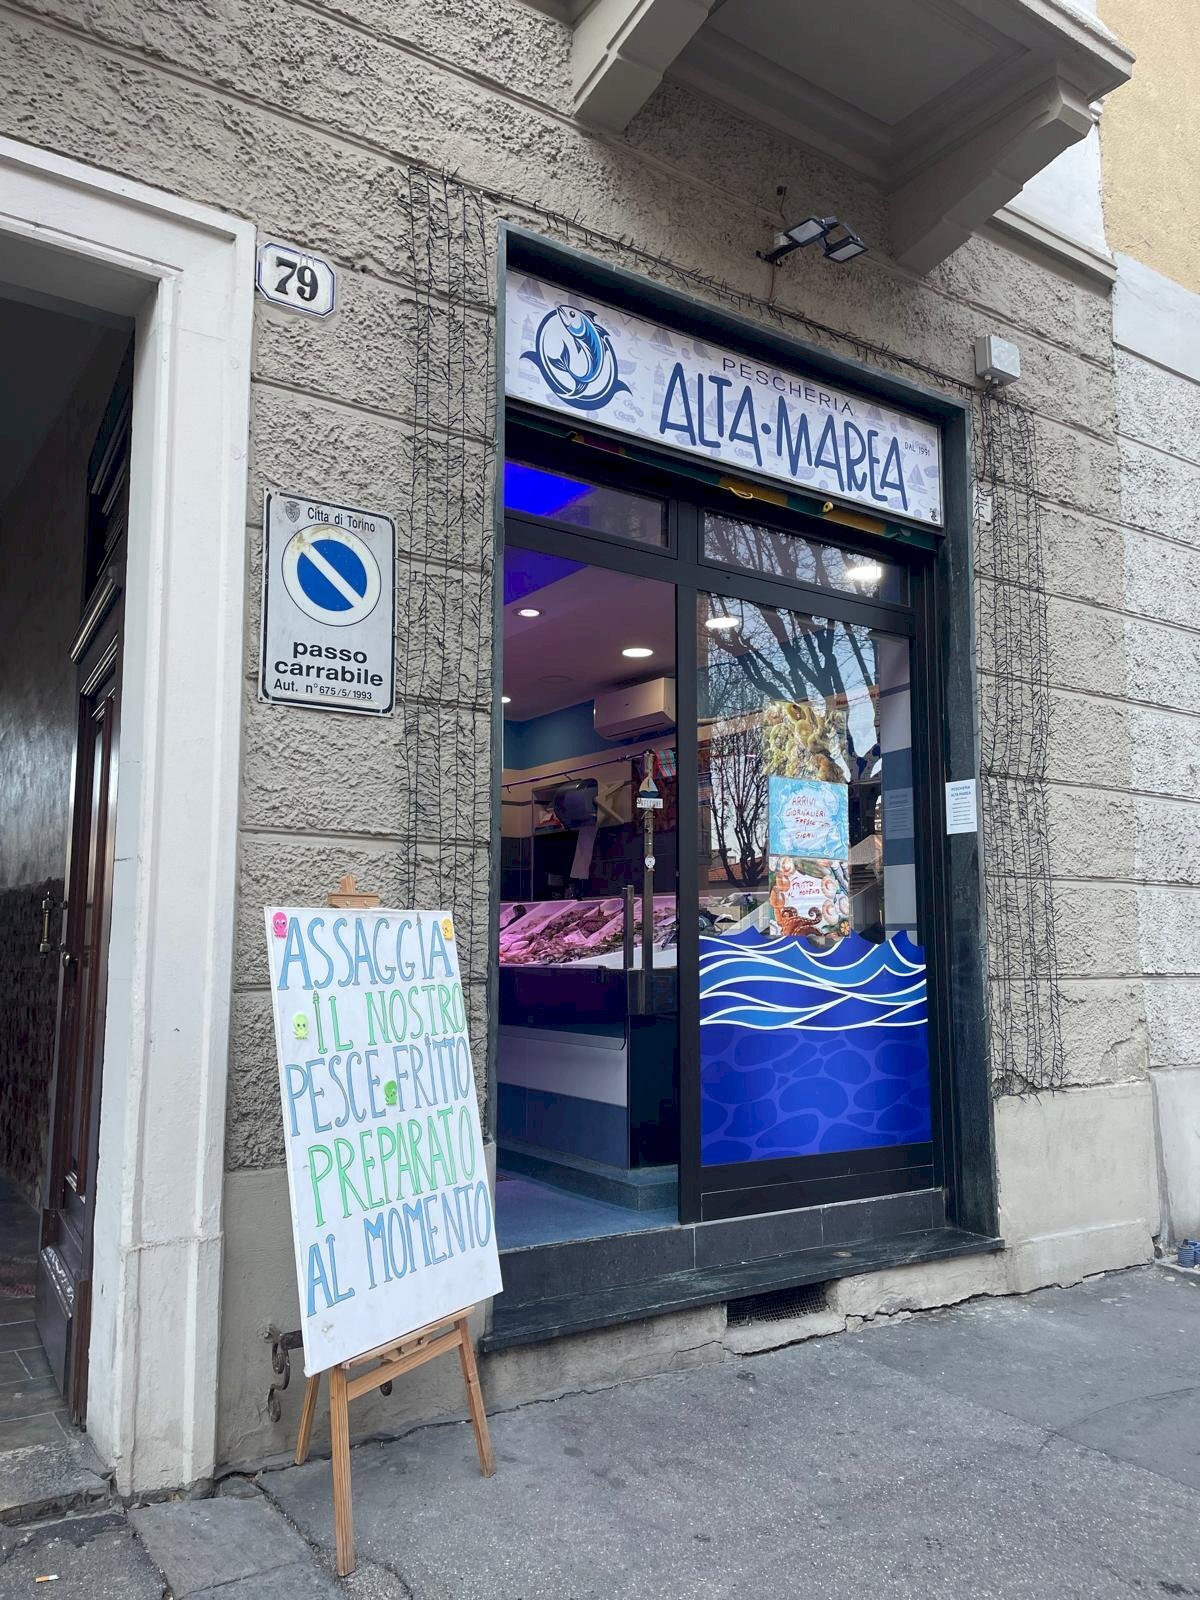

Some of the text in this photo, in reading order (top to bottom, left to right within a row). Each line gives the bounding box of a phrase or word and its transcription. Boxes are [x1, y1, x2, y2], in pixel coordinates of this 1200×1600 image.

[275, 256, 319, 302] 79
[722, 357, 854, 416] PESCHERIA
[904, 441, 931, 457] DAL 1991
[334, 513, 343, 525] di
[347, 515, 376, 532] Torino
[274, 660, 384, 687] carrabile
[293, 641, 368, 664] passo
[273, 678, 299, 692] Aut.
[277, 912, 455, 991] ASSAGGIA
[312, 982, 467, 1054] IL NOSTRO
[284, 1033, 471, 1137] PESCE FRITTO
[307, 1105, 477, 1228] PREPARATO
[307, 1180, 492, 1318] AL MOMENTO
